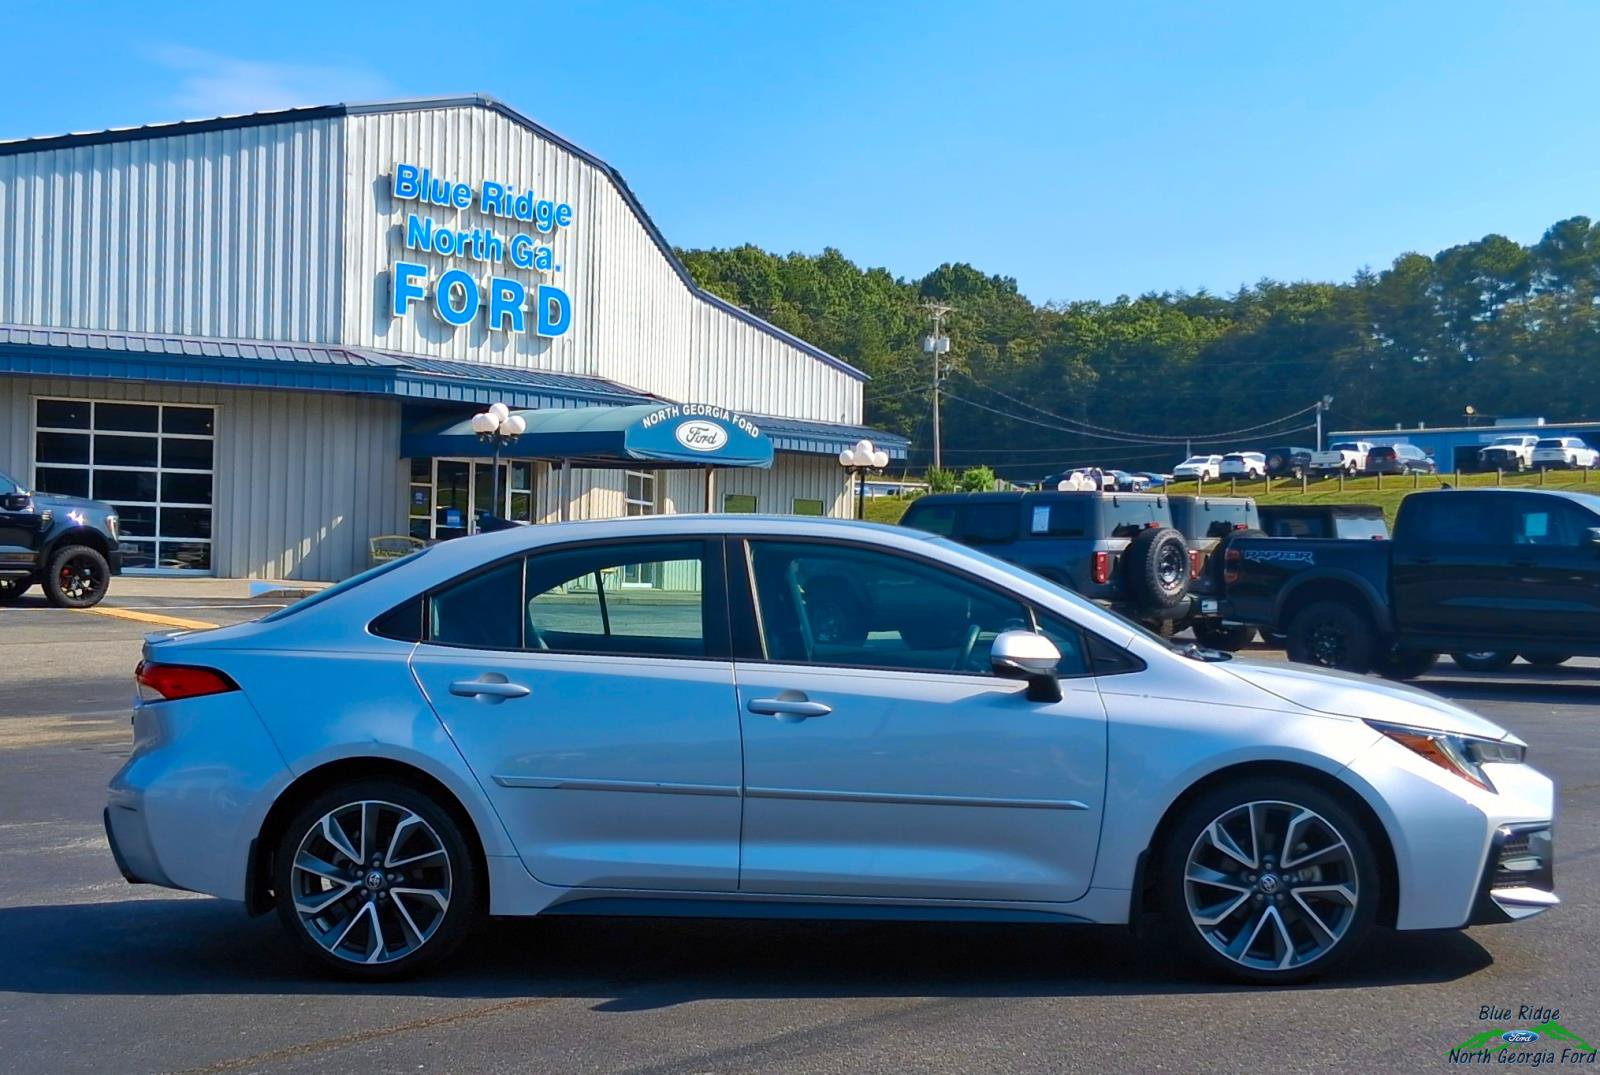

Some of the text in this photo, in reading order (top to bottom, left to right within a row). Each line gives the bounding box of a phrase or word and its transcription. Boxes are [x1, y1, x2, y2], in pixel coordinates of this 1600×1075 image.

[394, 163, 573, 233] Blue Ridge
[406, 213, 561, 272] North Ga.
[393, 260, 572, 339] FORD
[642, 404, 760, 439] NORTH GEORGIA FORD
[686, 426, 718, 445] Ford
[1244, 550, 1315, 565] RAPTOR
